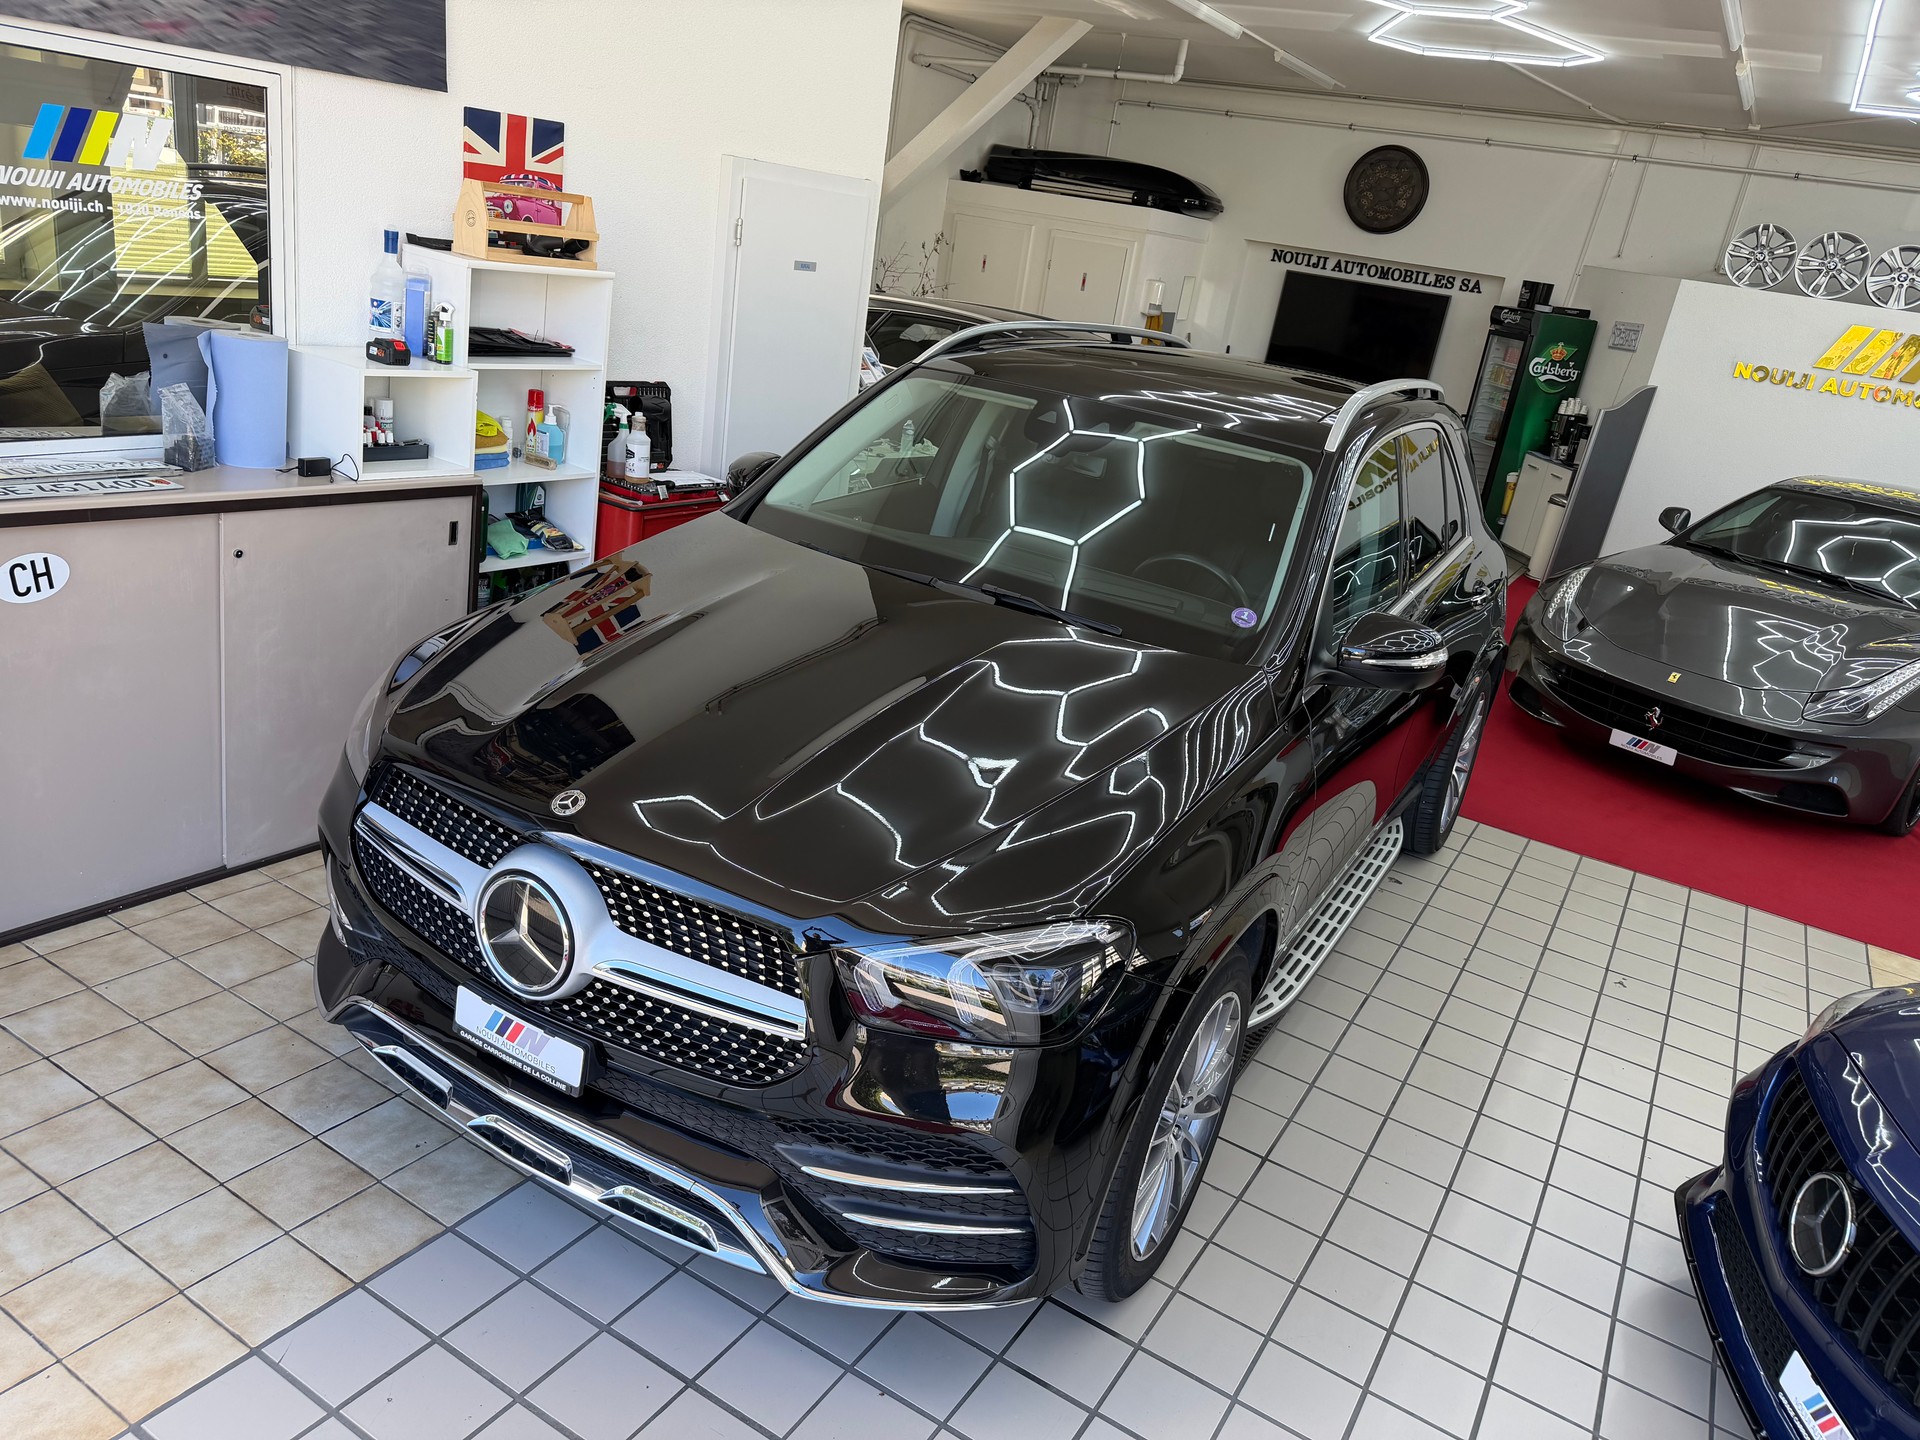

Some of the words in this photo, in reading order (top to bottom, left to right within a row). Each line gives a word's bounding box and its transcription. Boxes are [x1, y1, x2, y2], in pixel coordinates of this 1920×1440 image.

[0, 165, 67, 189] NOUIJI
[67, 172, 204, 200] AUTOMOBILES
[0, 195, 104, 213] www.nouiji.ch
[1271, 249, 1329, 271] NOUIJI
[1331, 258, 1456, 289] AUTOMOBILES
[1459, 277, 1483, 294] SA
[1500, 309, 1521, 323] Carlsberg
[1529, 357, 1579, 382] Carlsberg
[1733, 361, 1816, 391] NOUIJI
[9, 556, 55, 597] CH
[460, 1030, 483, 1046] GARAGE
[483, 1043, 522, 1069] CARROSSERIE
[523, 1064, 532, 1074] DE
[532, 1068, 541, 1079] LA
[541, 1073, 567, 1092] COLLINE
[476, 1025, 500, 1046] NOUIJI
[501, 1040, 556, 1074] AUTOMOBILES
